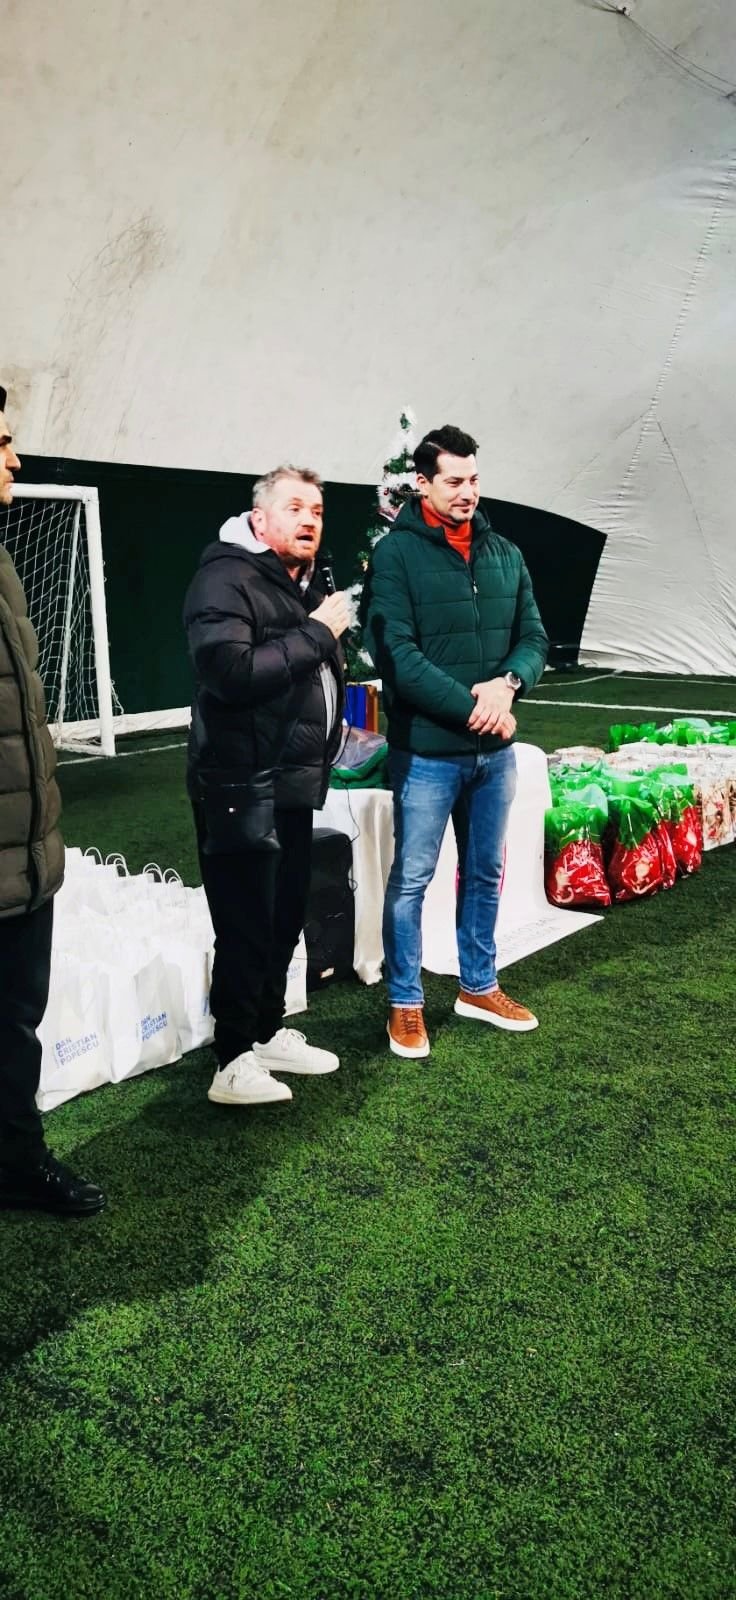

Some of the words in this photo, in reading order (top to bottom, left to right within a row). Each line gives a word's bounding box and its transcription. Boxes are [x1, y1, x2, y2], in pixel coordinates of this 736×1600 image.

[56, 1037, 72, 1050] DAN
[58, 1033, 97, 1057] CRISTIAN
[60, 1041, 99, 1065] POPESCU
